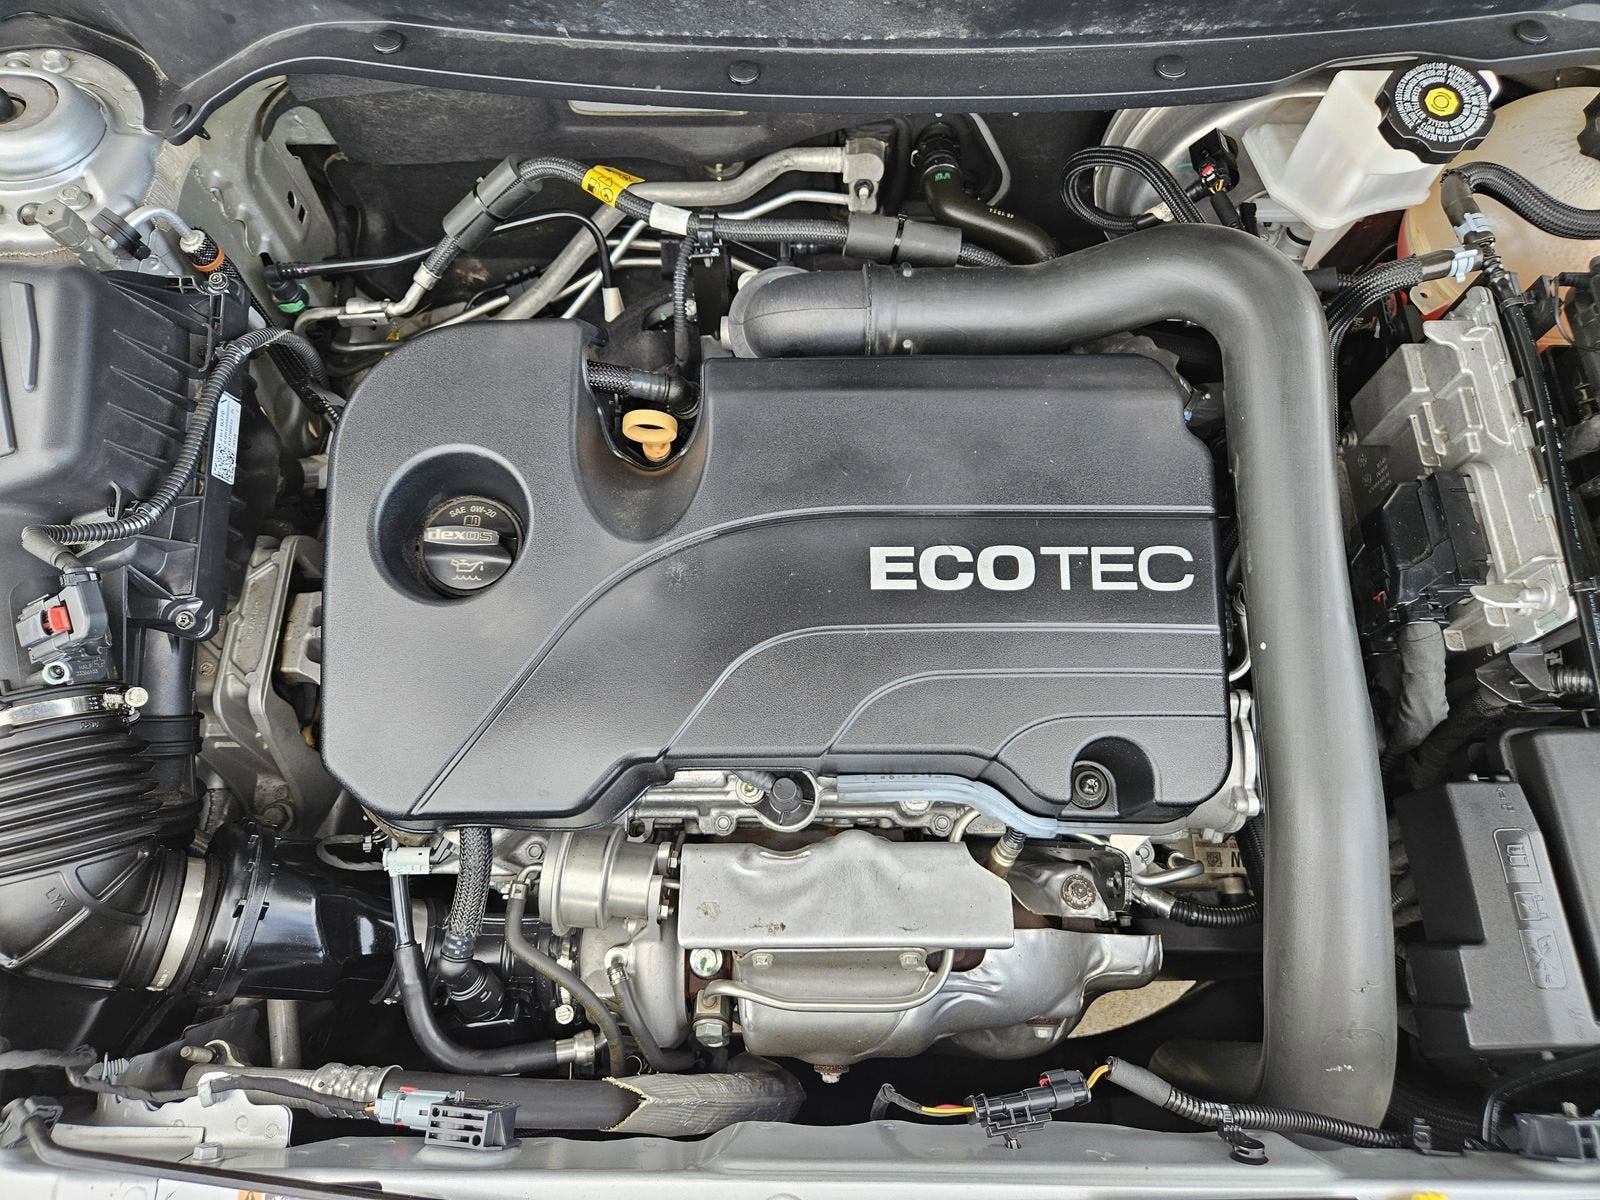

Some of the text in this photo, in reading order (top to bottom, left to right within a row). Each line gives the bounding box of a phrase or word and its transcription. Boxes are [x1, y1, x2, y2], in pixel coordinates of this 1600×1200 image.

[449, 506, 497, 518] SAE 0W-20
[428, 528, 493, 541] dexos
[869, 544, 1195, 591] ECOTEC
[45, 886, 70, 913] LYX
